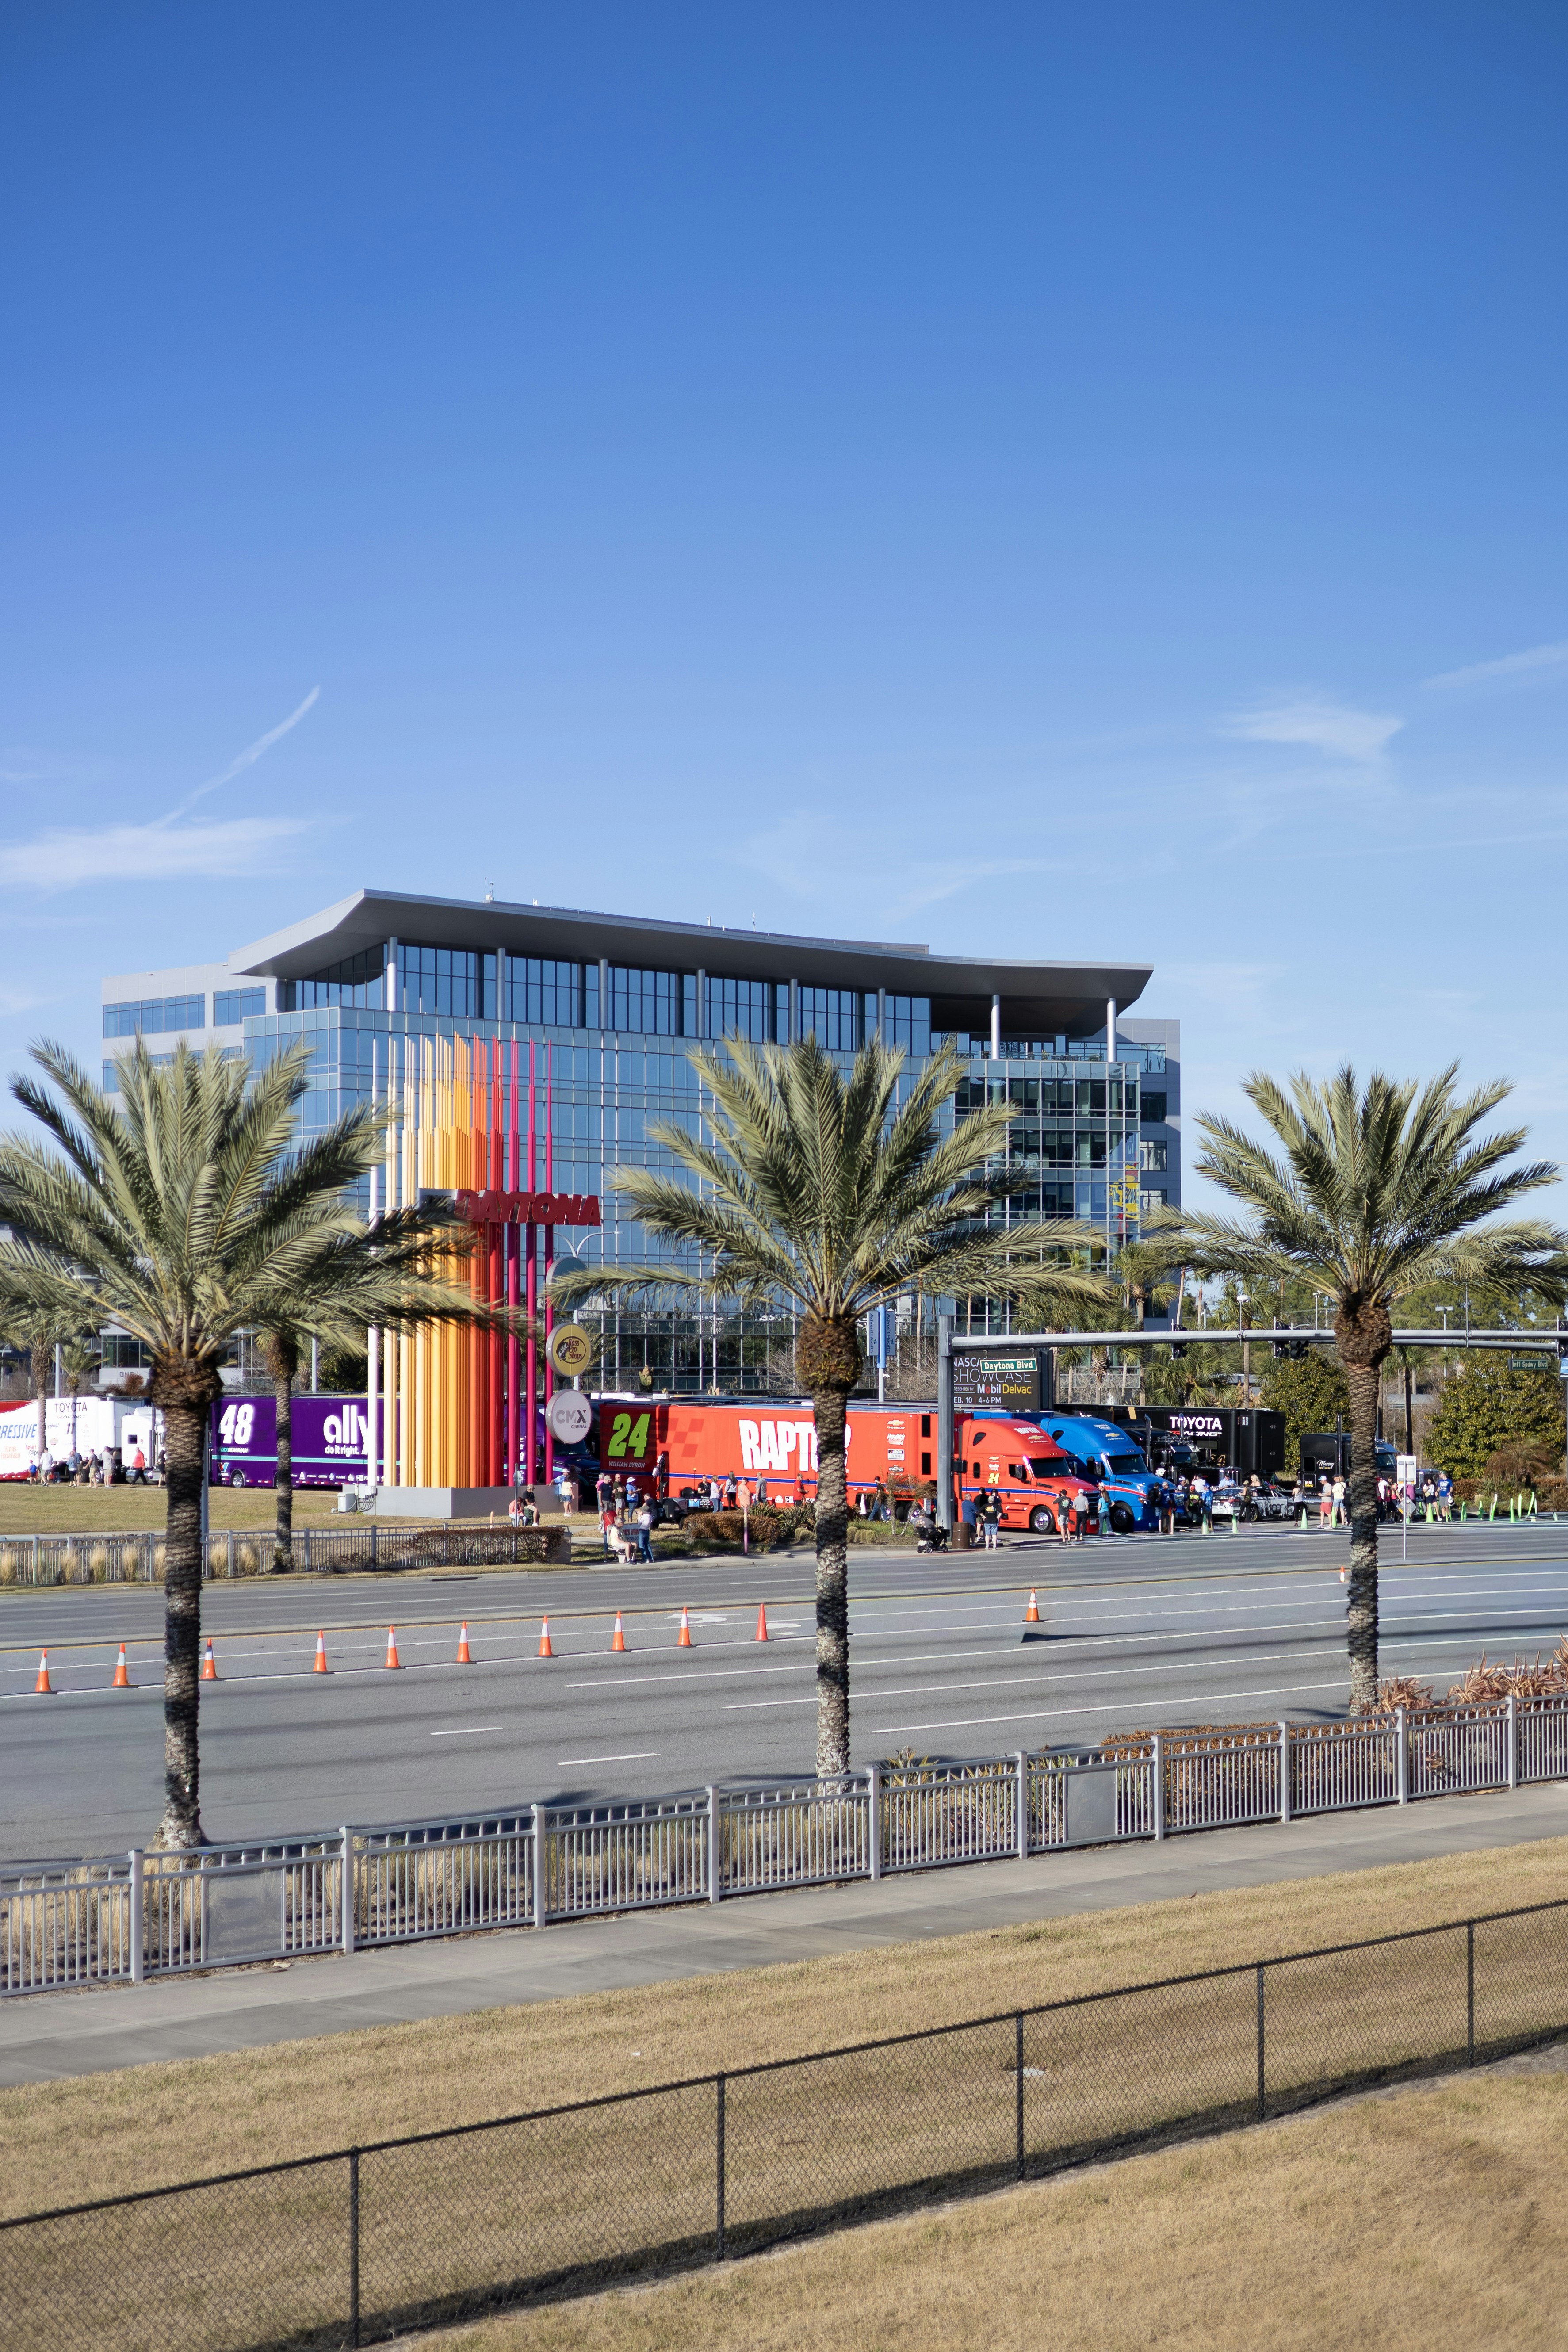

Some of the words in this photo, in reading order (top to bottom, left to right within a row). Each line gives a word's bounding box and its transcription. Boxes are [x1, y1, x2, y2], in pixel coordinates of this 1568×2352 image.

[455, 1189, 600, 1226] DAYTONA
[568, 1352, 582, 1361] Shops
[984, 1362, 1014, 1371] Daytona
[977, 1384, 1001, 1394] Mobil
[1002, 1384, 1032, 1394] Delvac
[54, 1402, 88, 1413] TOYOTA
[555, 1410, 586, 1424] CMX
[66, 1423, 76, 1434] 11
[218, 1404, 253, 1445] 48
[1170, 1416, 1222, 1430] TOYOTA
[608, 1413, 650, 1457] 24
[325, 1445, 334, 1454] do
[335, 1445, 340, 1454] it
[1317, 1460, 1335, 1469] Massey
[988, 1473, 1000, 1484] 24
